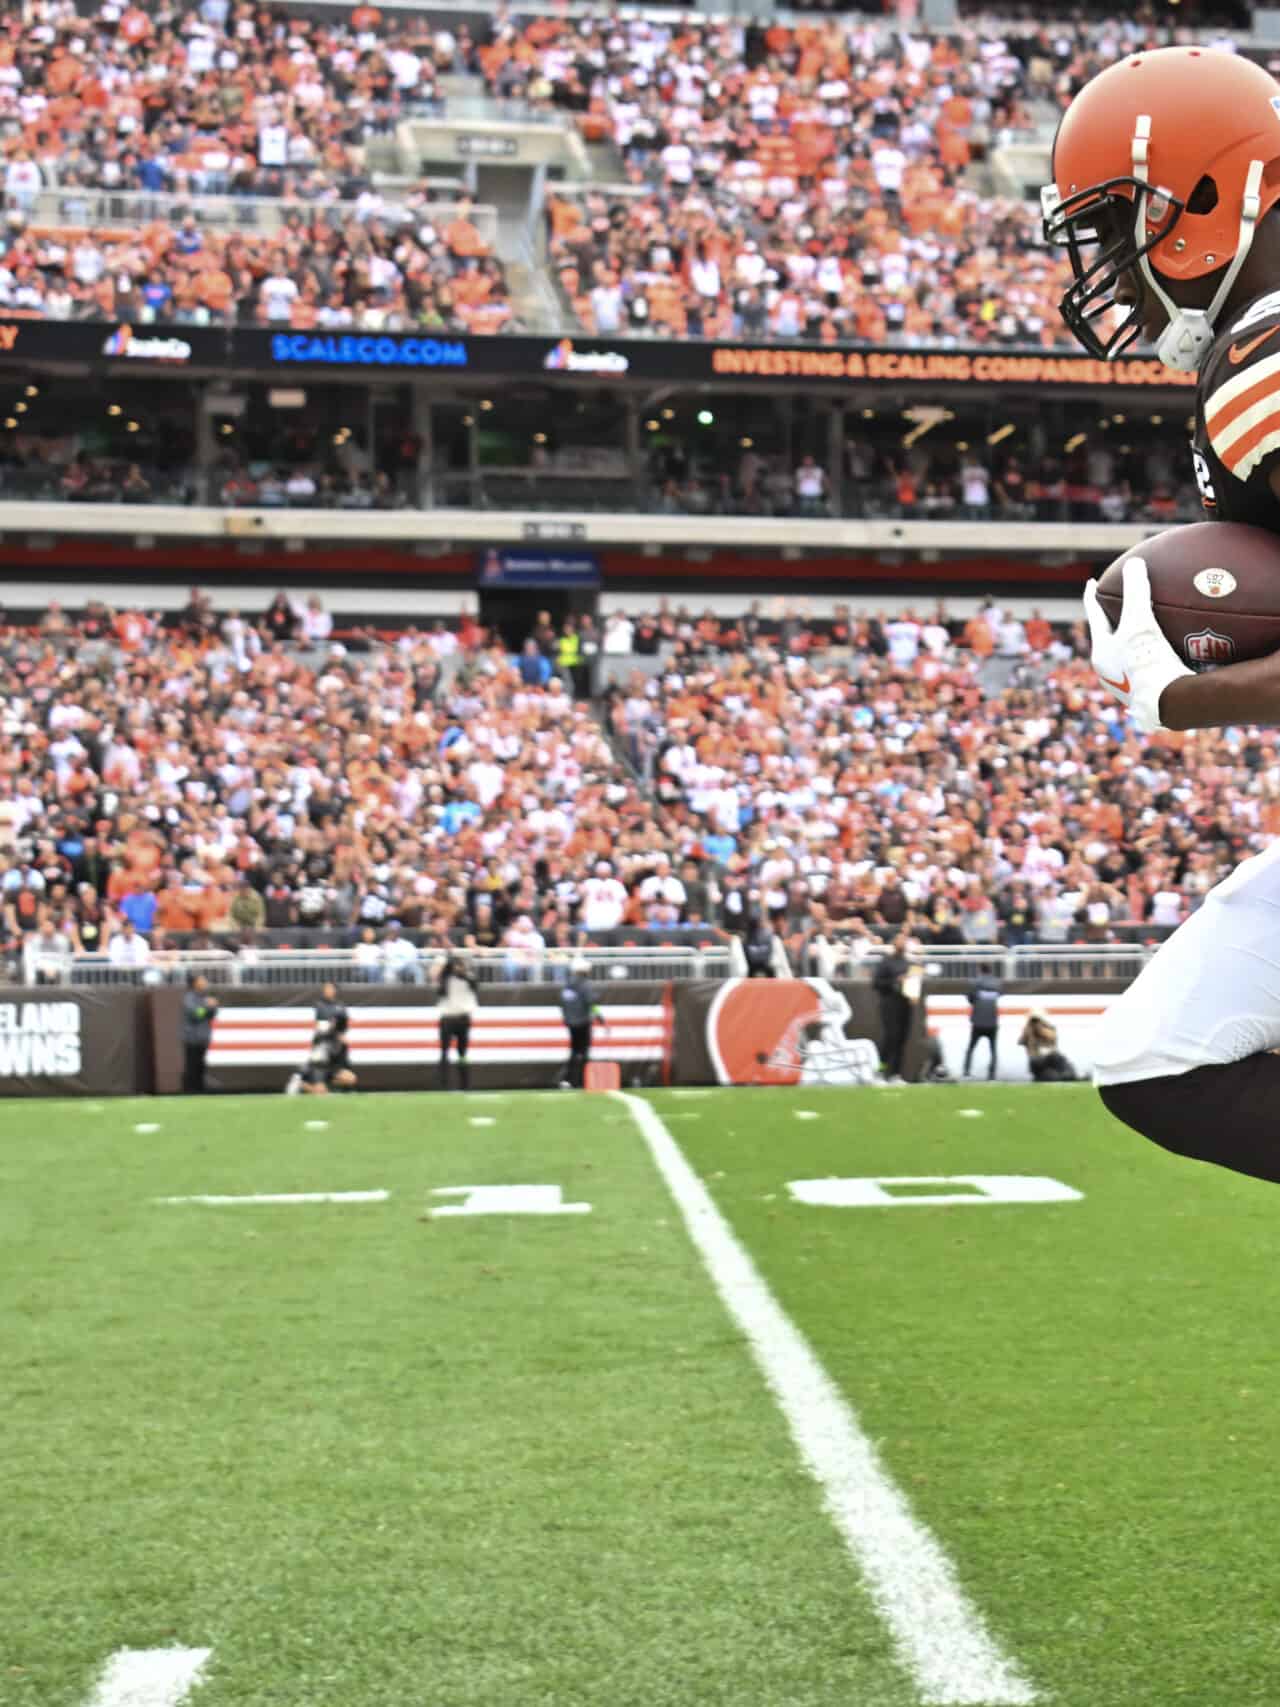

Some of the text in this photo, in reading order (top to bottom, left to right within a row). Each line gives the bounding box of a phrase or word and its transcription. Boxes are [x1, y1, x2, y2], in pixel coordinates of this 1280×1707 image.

[272, 333, 468, 366] SCALECO.COM
[712, 348, 844, 377] INVESTING
[846, 352, 866, 378] &
[866, 352, 971, 380] SCALING
[972, 355, 1113, 385] COMPANIES
[1189, 636, 1229, 659] NFL
